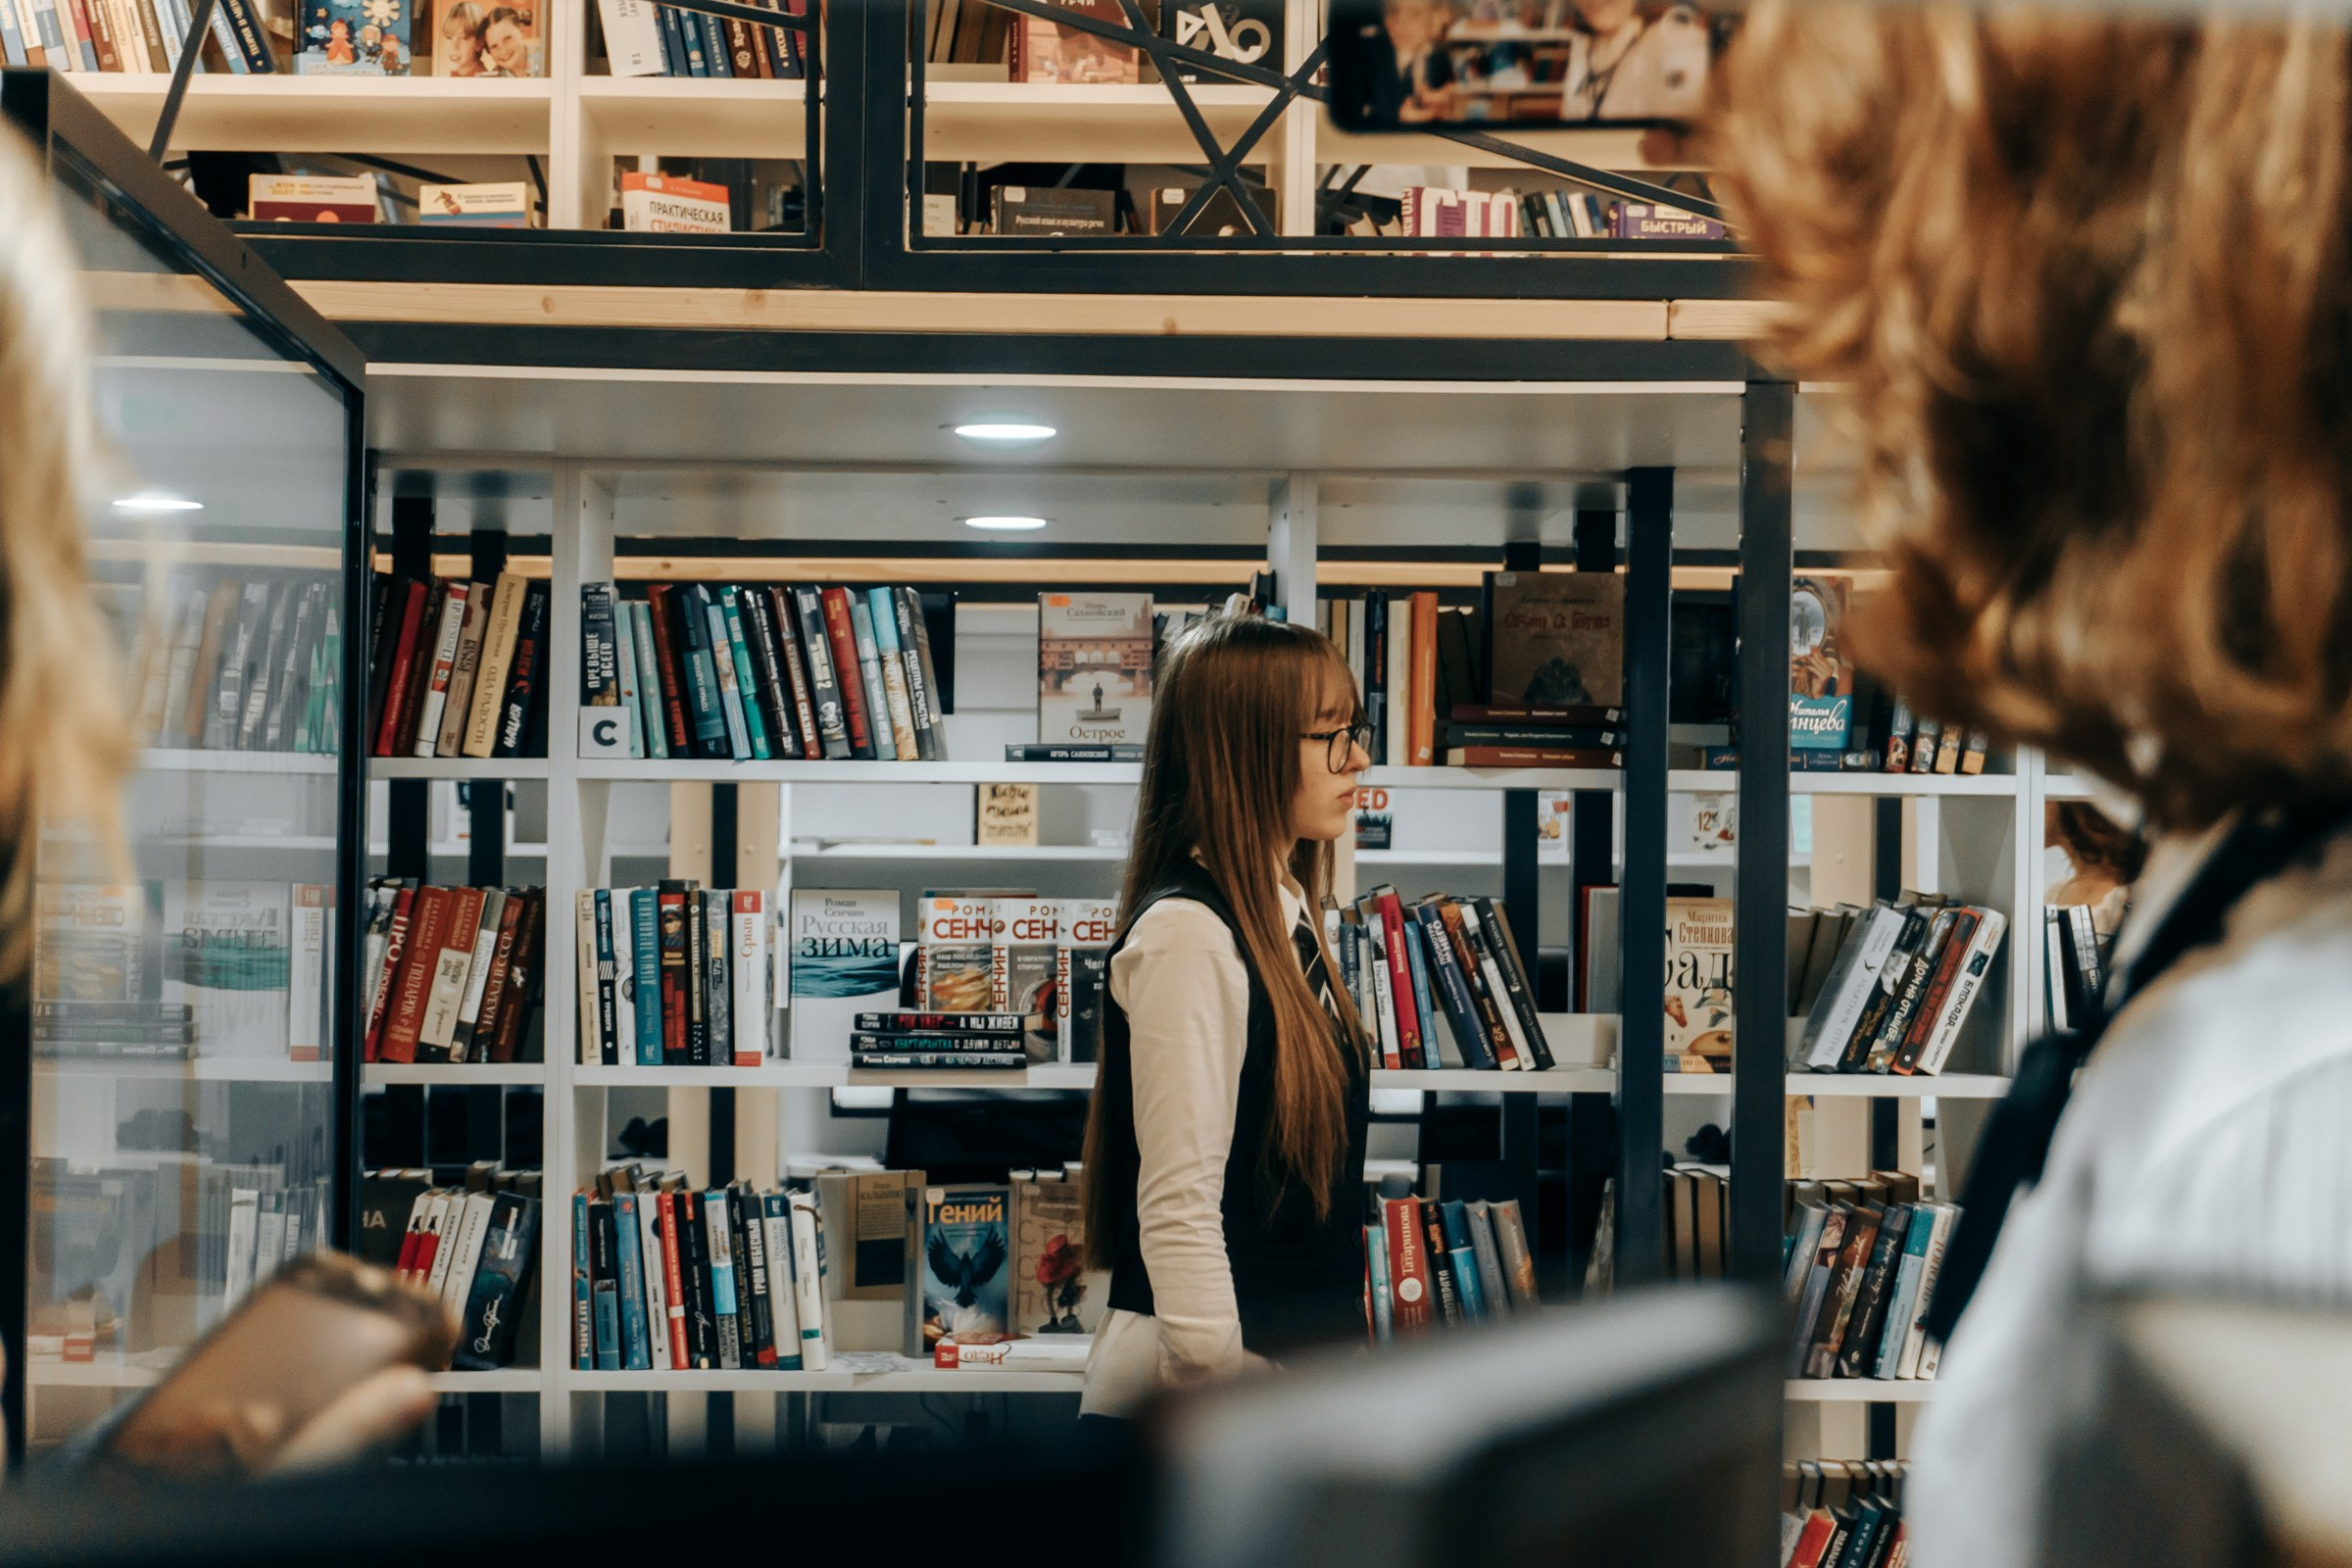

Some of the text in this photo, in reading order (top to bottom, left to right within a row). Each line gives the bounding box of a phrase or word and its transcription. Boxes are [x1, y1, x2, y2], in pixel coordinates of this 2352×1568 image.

[650, 201, 724, 224] ПРАКТИЧЕСКАЯ
[1640, 220, 1708, 235] БЫСТРЫЙ
[1066, 608, 1126, 618] Сахновский
[1085, 602, 1107, 612] Игорь
[586, 632, 601, 689] ПРЕВЫШЕ
[600, 642, 614, 678] ВСЕГО
[474, 666, 499, 744] ОДА РАДОСТИ
[787, 643, 813, 743] СТРАШНАЯ СКАЗКА
[907, 649, 930, 730] РЕЦЕПТЫ СЧАСТЬЯ
[1790, 698, 1830, 716] Наталья
[503, 703, 522, 748] НАЦИЯ
[1790, 699, 1847, 734] нцева
[824, 898, 858, 907] Роман
[824, 908, 865, 917] Сенчин
[951, 905, 993, 917] РОМ
[1687, 910, 1728, 924] Марина
[386, 915, 410, 962] ПРО
[741, 917, 758, 957] Срыв
[802, 915, 889, 937] Русская
[1426, 922, 1446, 965] ПОСМОТРИ
[1432, 919, 1452, 965] НА НЕГО
[1488, 918, 1504, 948] КОРОЛЬ
[1679, 921, 1734, 944] Степнова
[801, 937, 893, 958] зима
[405, 961, 425, 1015] ПОДАРОК
[482, 931, 514, 1026] НАЗАД В СССР
[1057, 949, 1069, 1018] СЕНЧИН
[1885, 956, 1930, 1043] ДОМ НА ОТШИБЕ
[899, 1015, 916, 1028] РОК
[919, 1014, 945, 1028] УМЕР
[959, 1016, 966, 1029] А
[970, 1016, 985, 1029] МЫ
[894, 1038, 953, 1050] КВАРТИРАНТКА
[962, 1039, 990, 1051] ДВУМЯ
[993, 1039, 1021, 1050] ДЕТЬМИ
[927, 1196, 1003, 1224] Гений
[747, 1218, 767, 1295] ГРОМ НЕБЕСНЫЙ
[1400, 1203, 1416, 1277] Татаринова
[1439, 1269, 1455, 1327] ЕВОЗВРАТА
[579, 1299, 590, 1358] ШТАНЫ
